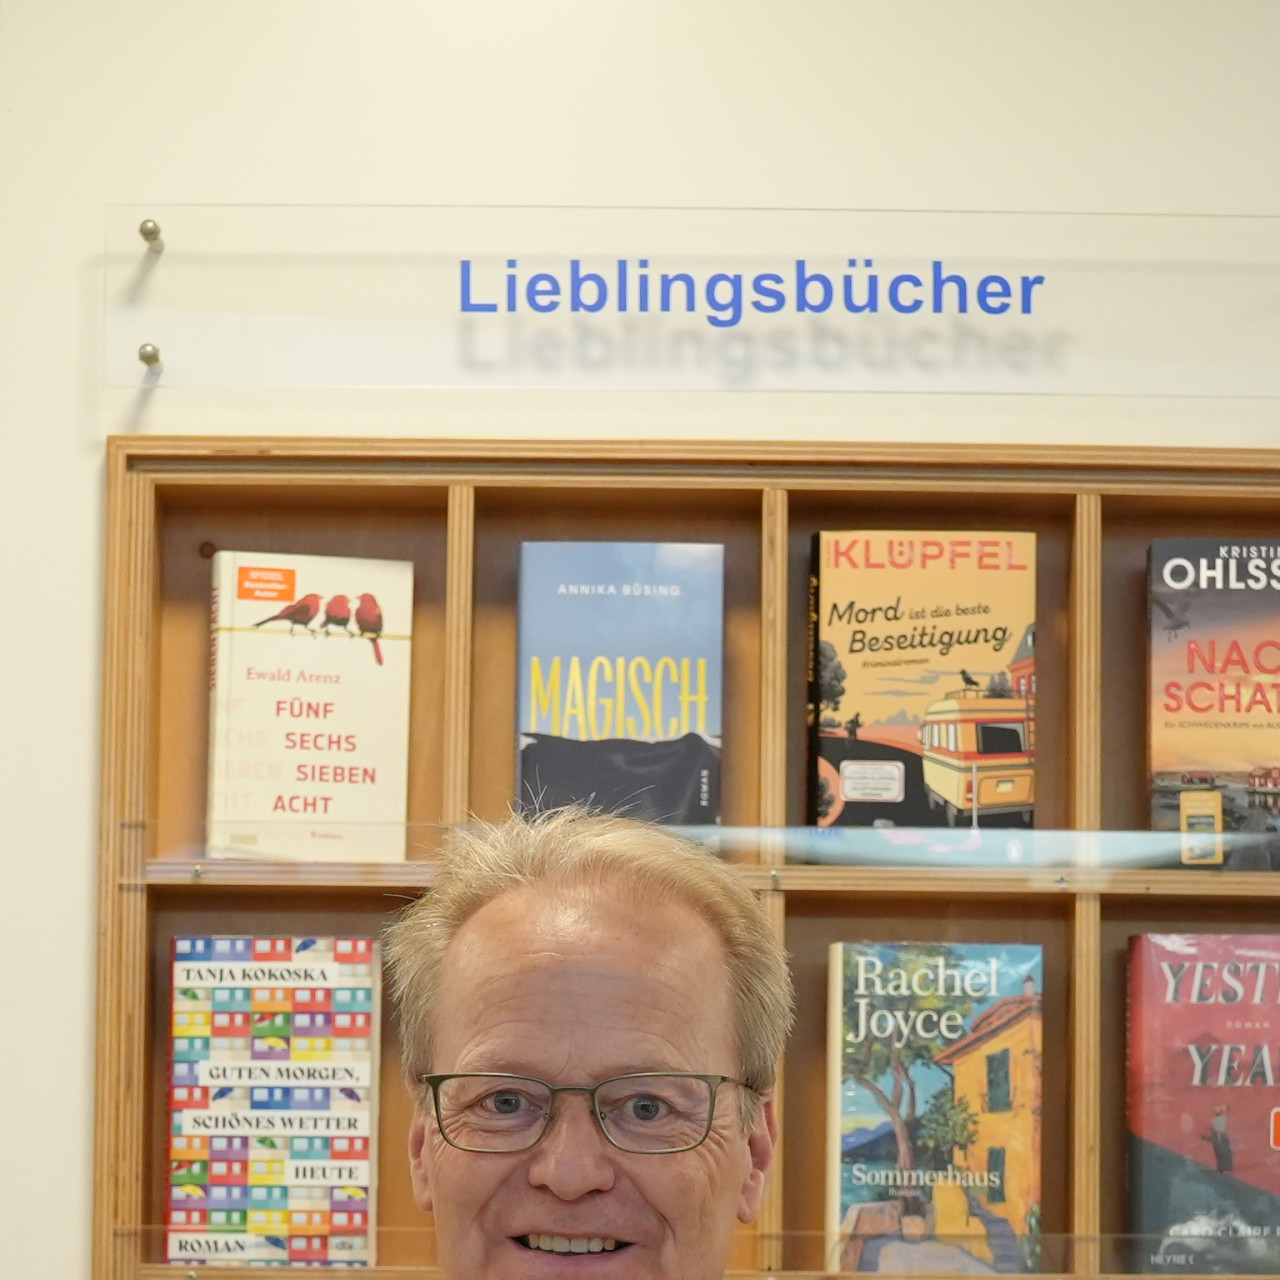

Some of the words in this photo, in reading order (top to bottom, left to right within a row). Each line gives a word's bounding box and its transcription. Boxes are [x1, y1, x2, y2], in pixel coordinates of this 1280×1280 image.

[458, 258, 1046, 327] Lieblingsbücher
[832, 538, 1028, 571] KLÜPFEL
[557, 584, 617, 597] ANNIKA
[621, 582, 681, 597] BÜSING
[828, 596, 904, 626] Mord
[908, 606, 926, 619] ist
[930, 604, 951, 618] die
[955, 602, 991, 617] beste
[849, 625, 1012, 656] Beseitigung
[246, 667, 291, 683] Ewald
[296, 668, 342, 685] Arenz
[275, 696, 335, 719] FÜNF
[530, 655, 709, 741] MAGISCH
[284, 732, 357, 752] SECHS
[295, 764, 377, 785] SIEBEN
[272, 794, 333, 814] ACHT
[182, 966, 237, 984] TANJA
[242, 966, 329, 983] KOKOSKA
[853, 954, 1001, 998] Rachel
[850, 998, 964, 1050] Joyce
[1226, 1019, 1272, 1030] ROMAN
[208, 1064, 270, 1082] GUTEN
[274, 1065, 361, 1083] MORGEN,
[192, 1110, 276, 1131] SCHÖNES
[281, 1114, 359, 1131] WETTER
[294, 1164, 359, 1181] HEUTE
[851, 1163, 1001, 1188] Sommerhaus
[178, 1238, 247, 1254] ROMAN
